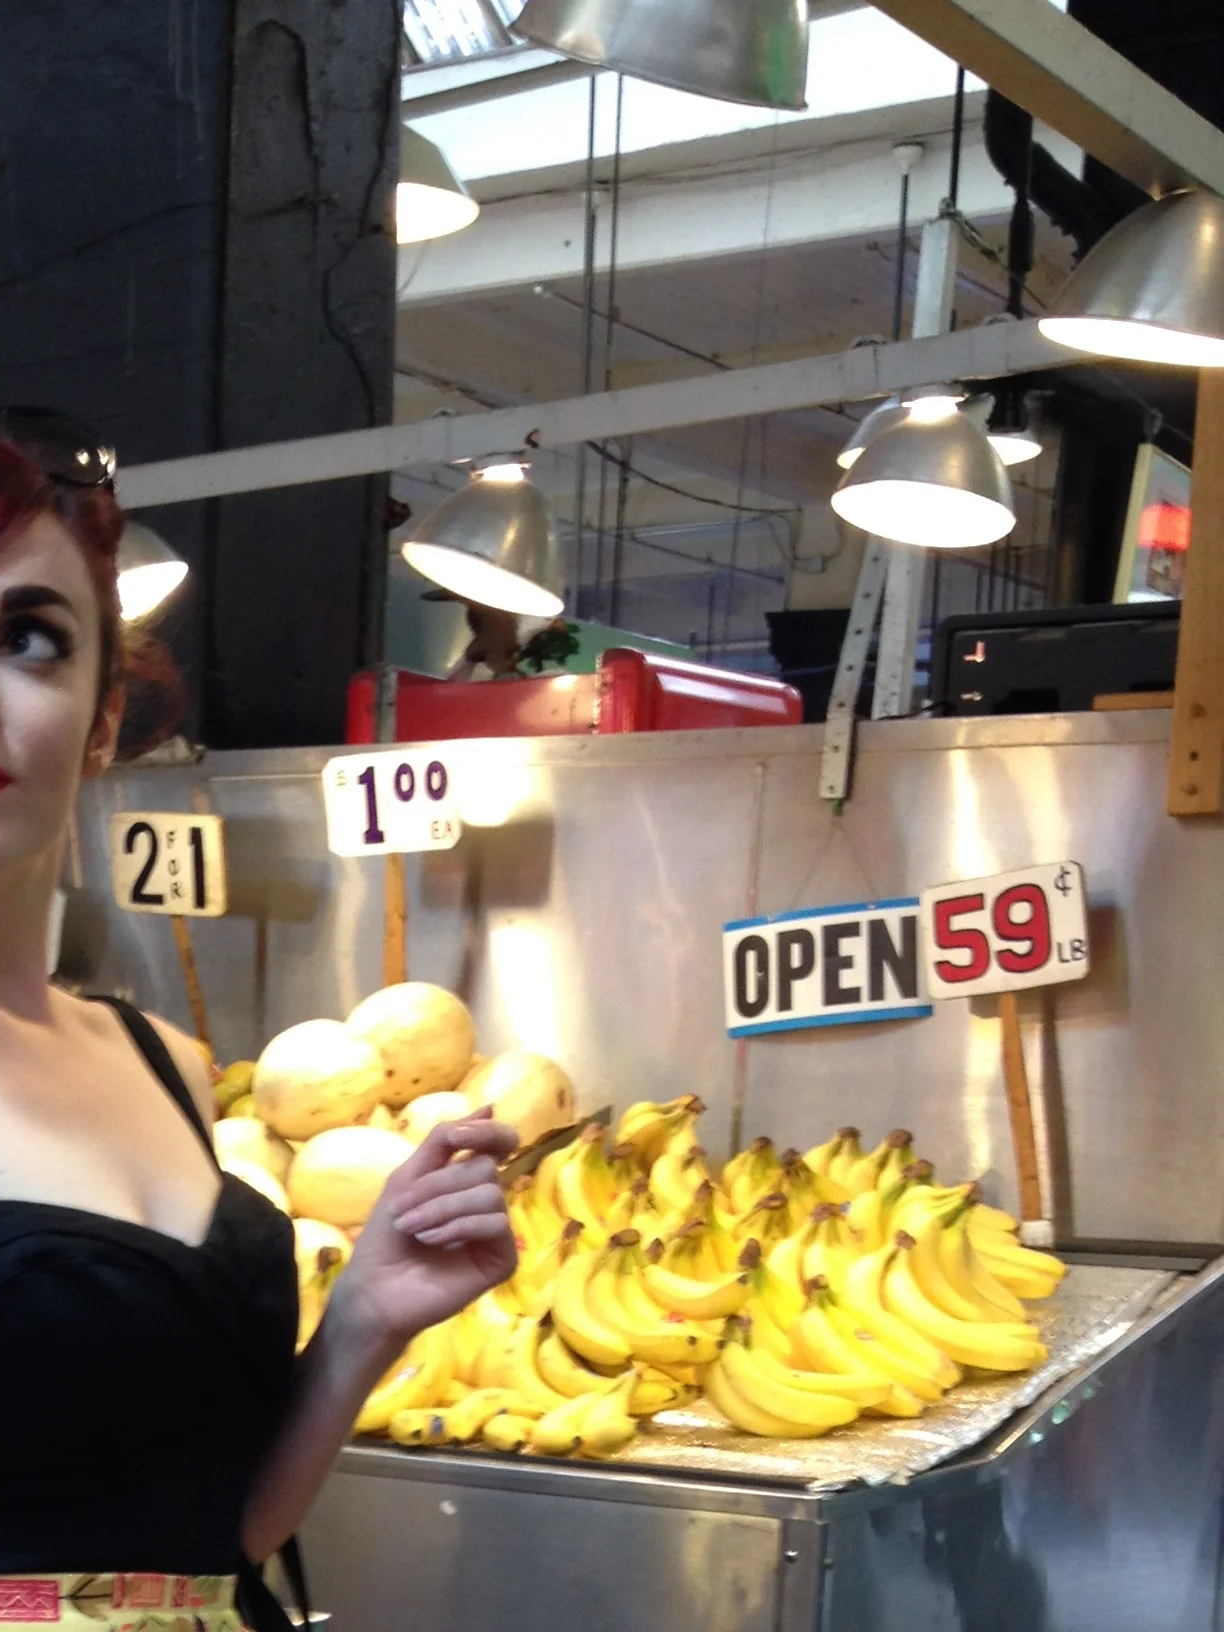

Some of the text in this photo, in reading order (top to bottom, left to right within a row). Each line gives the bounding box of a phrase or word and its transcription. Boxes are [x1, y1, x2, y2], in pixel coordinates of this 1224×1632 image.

[125, 821, 164, 905] 2
[189, 826, 206, 909] 1
[733, 915, 918, 1018] OPEN
[1057, 939, 1086, 963] LB
